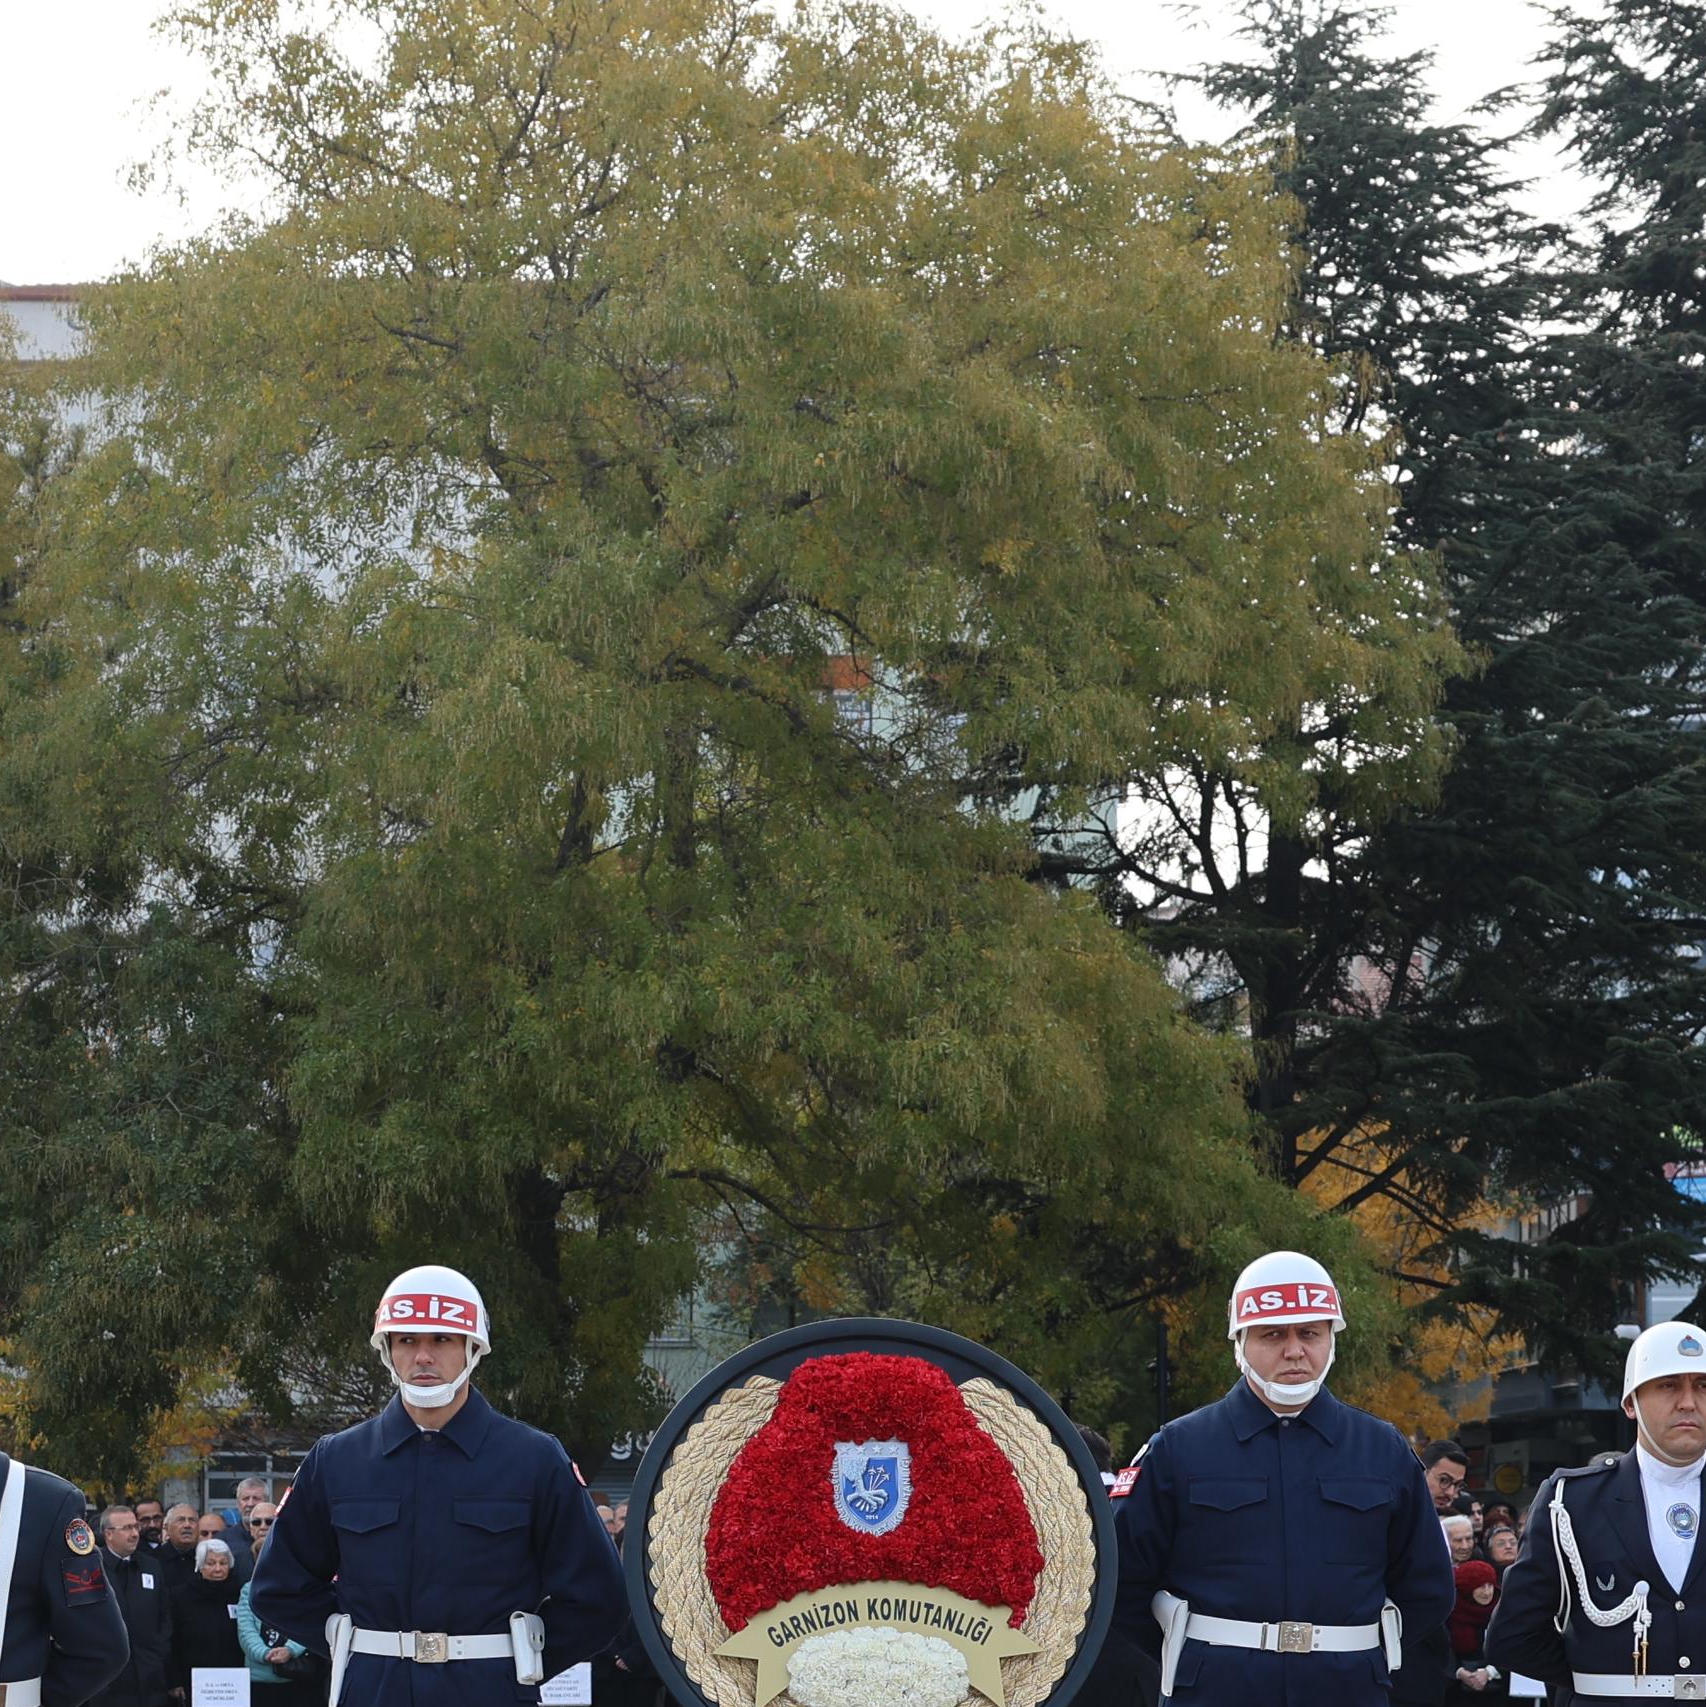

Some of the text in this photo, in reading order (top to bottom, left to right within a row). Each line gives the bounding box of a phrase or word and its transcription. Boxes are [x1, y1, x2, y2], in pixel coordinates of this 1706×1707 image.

[378, 1296, 473, 1327] AS.İZ.
[1240, 1285, 1336, 1317] AS.İZ.
[768, 1597, 994, 1648] GARNİZON KOMUTANLIĞI
